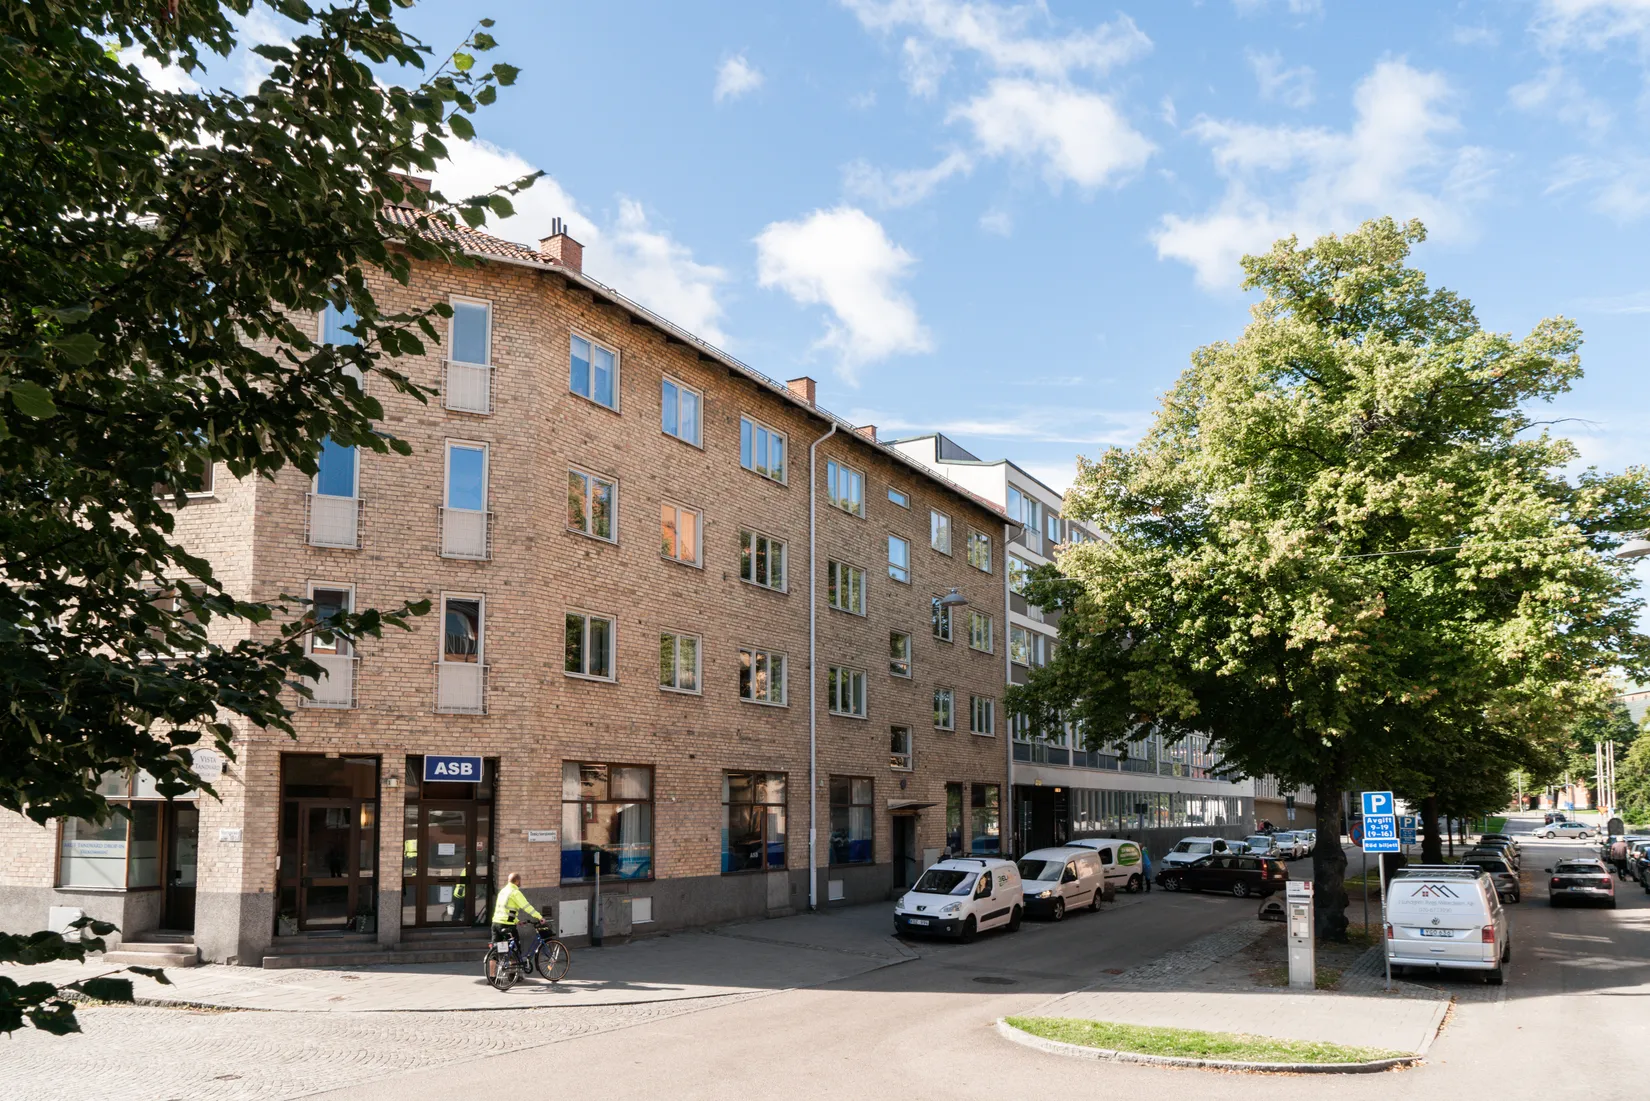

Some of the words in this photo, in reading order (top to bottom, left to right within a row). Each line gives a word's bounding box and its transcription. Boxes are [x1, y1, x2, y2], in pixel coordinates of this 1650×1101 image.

[200, 755, 216, 763] VISTA
[434, 762, 473, 775] ASB
[1371, 795, 1386, 813] P
[1404, 818, 1412, 827] P
